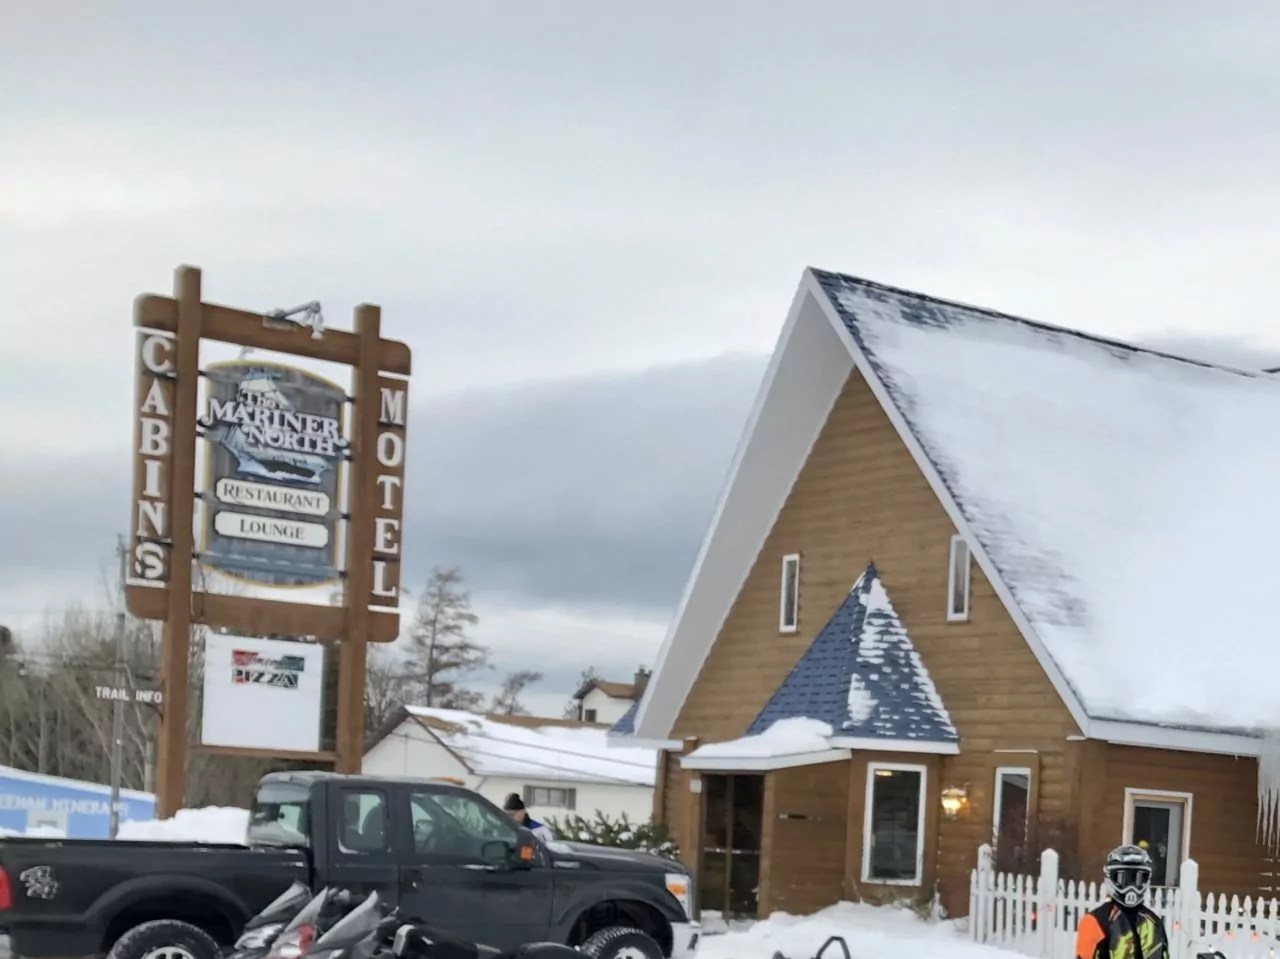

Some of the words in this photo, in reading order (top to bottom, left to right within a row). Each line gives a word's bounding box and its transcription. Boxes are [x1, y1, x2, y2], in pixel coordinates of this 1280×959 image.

[201, 397, 347, 447] MARINER
[241, 423, 336, 456] NORTH
[134, 335, 172, 579] CABINS
[222, 482, 323, 511] RESTAURANT
[373, 387, 405, 597] MOTEL
[239, 518, 306, 541] LOUNGE
[96, 685, 130, 701] TRAIL
[135, 689, 163, 704] INFO
